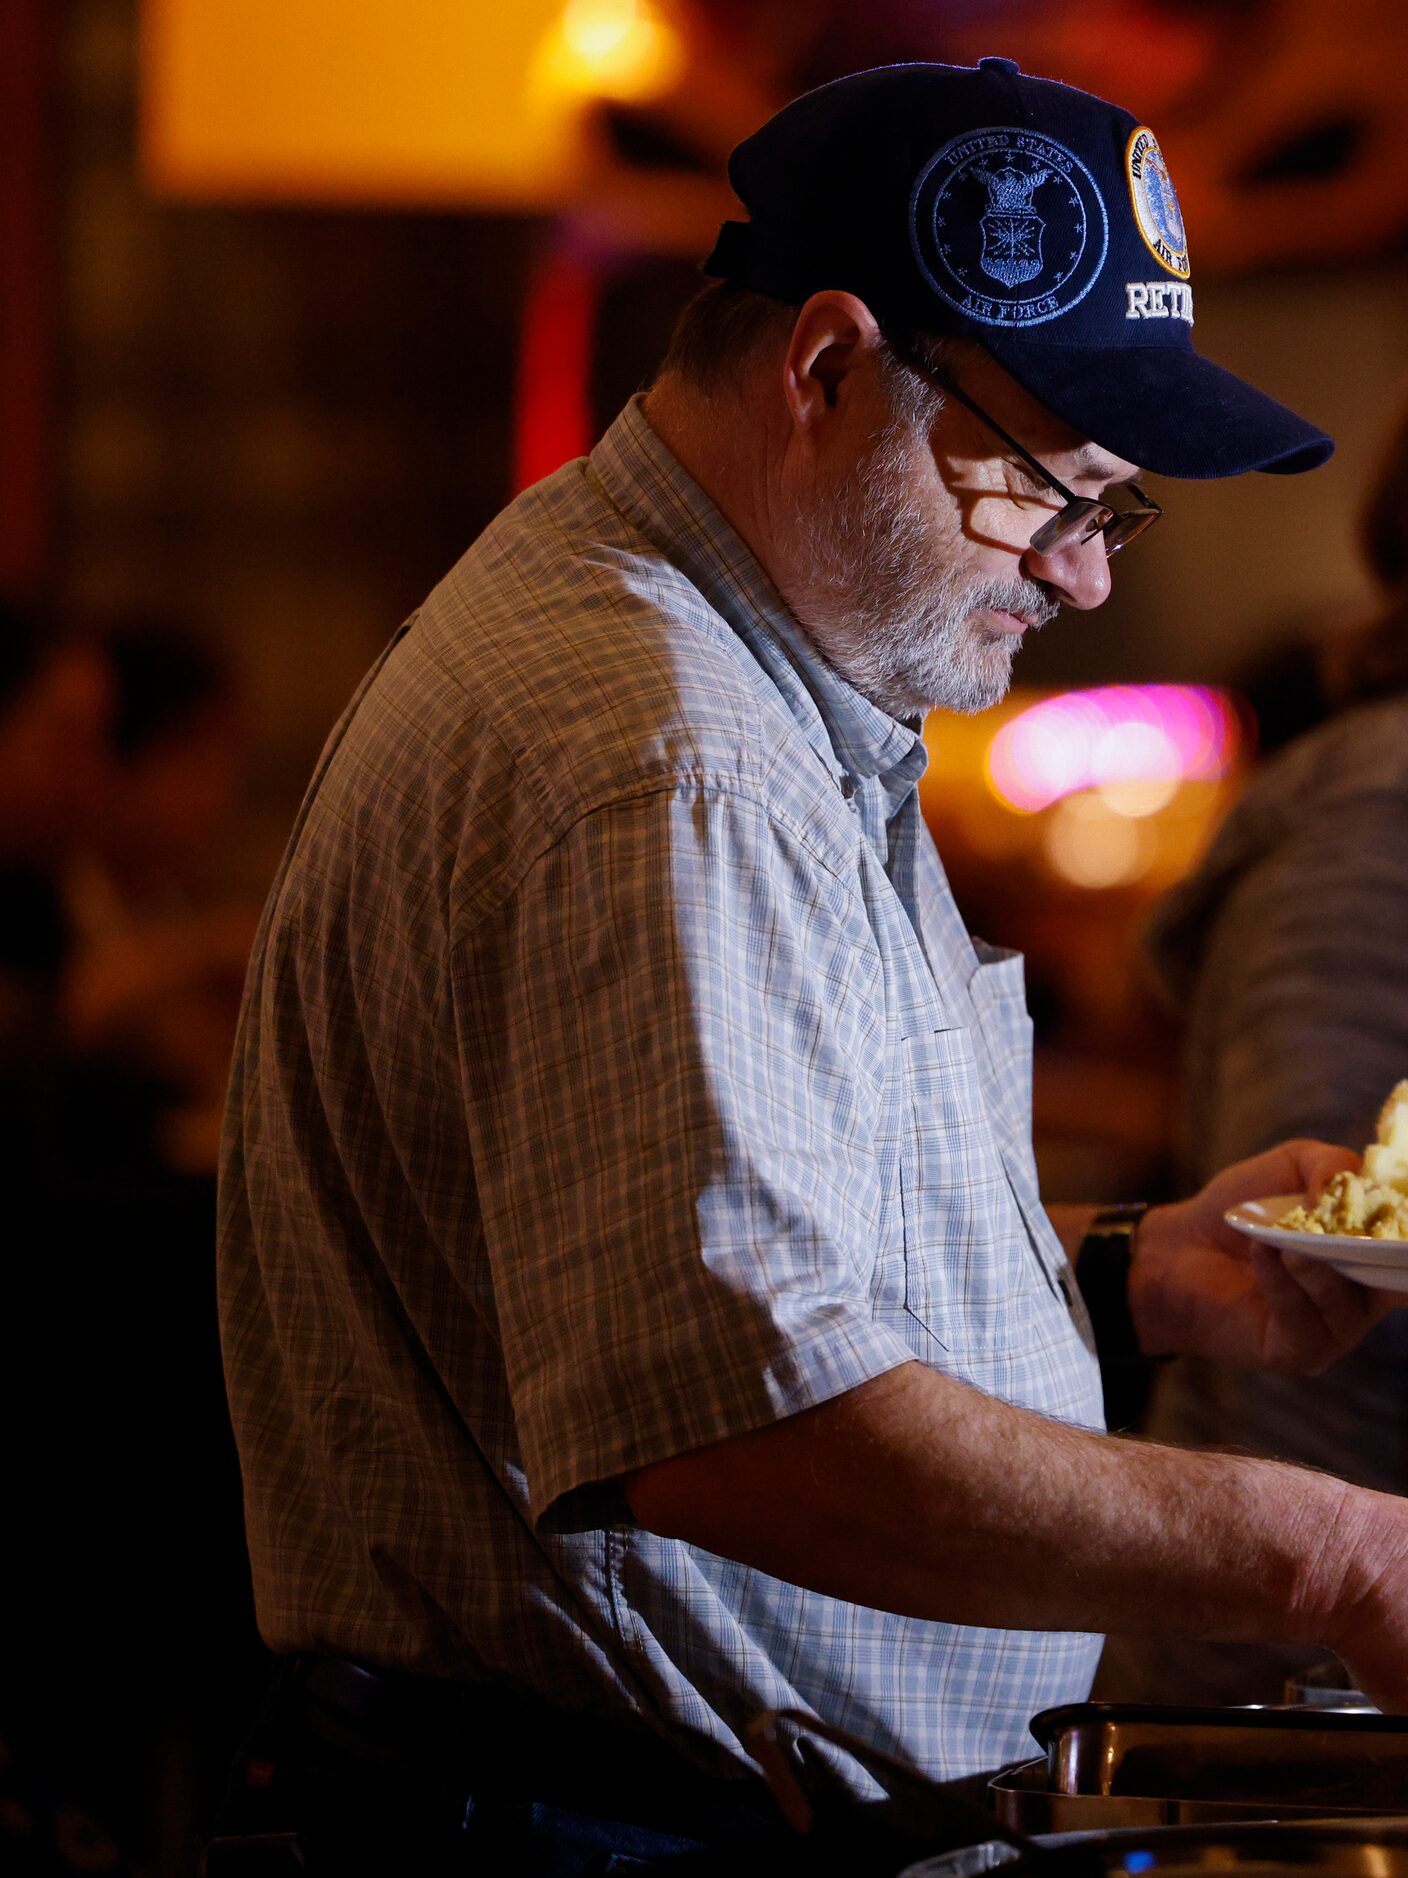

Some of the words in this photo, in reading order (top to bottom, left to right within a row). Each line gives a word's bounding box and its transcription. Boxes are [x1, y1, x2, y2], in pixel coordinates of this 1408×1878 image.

[945, 135, 1010, 166] UNITED
[1016, 136, 1074, 174] STATES
[1131, 133, 1149, 180] UNITED
[1153, 238, 1173, 266] AIR
[961, 295, 994, 316] AIR
[997, 295, 1060, 320] FORCE
[1125, 281, 1195, 328] RETI
